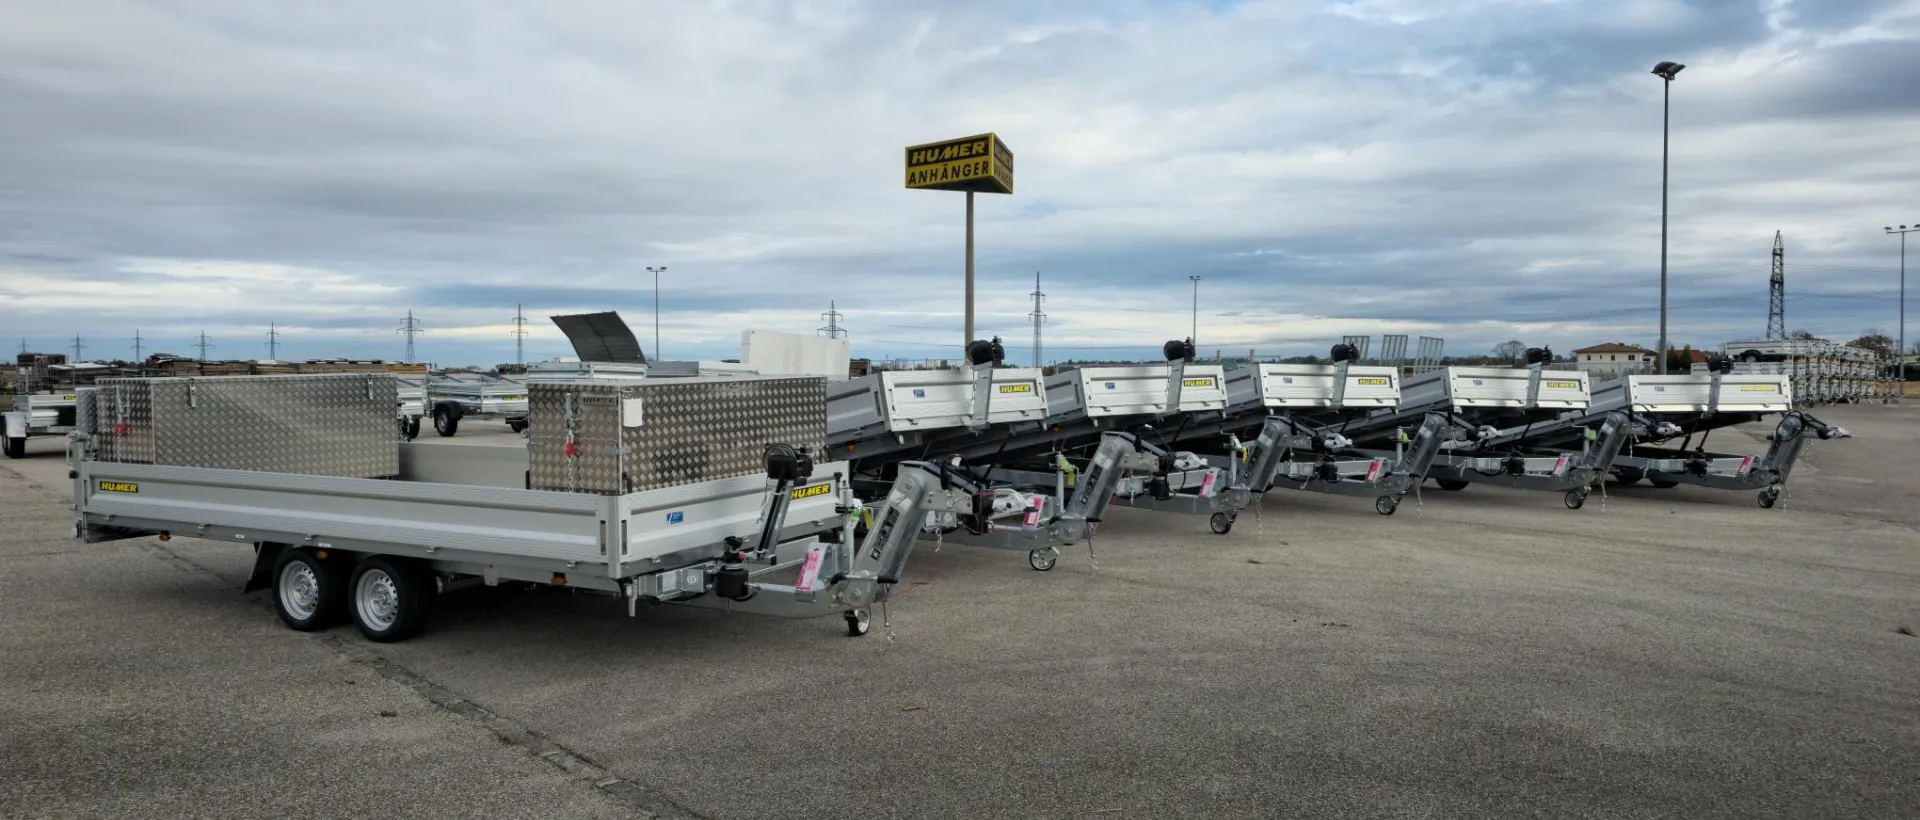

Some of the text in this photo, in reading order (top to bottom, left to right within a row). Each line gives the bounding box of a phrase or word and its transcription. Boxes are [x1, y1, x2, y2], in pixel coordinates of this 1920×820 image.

[912, 141, 985, 164] HUMER
[908, 160, 989, 186] ANHÄNGER
[1000, 385, 1030, 393] HUMER
[101, 482, 137, 492] HUMER
[791, 485, 829, 499] HUMER
